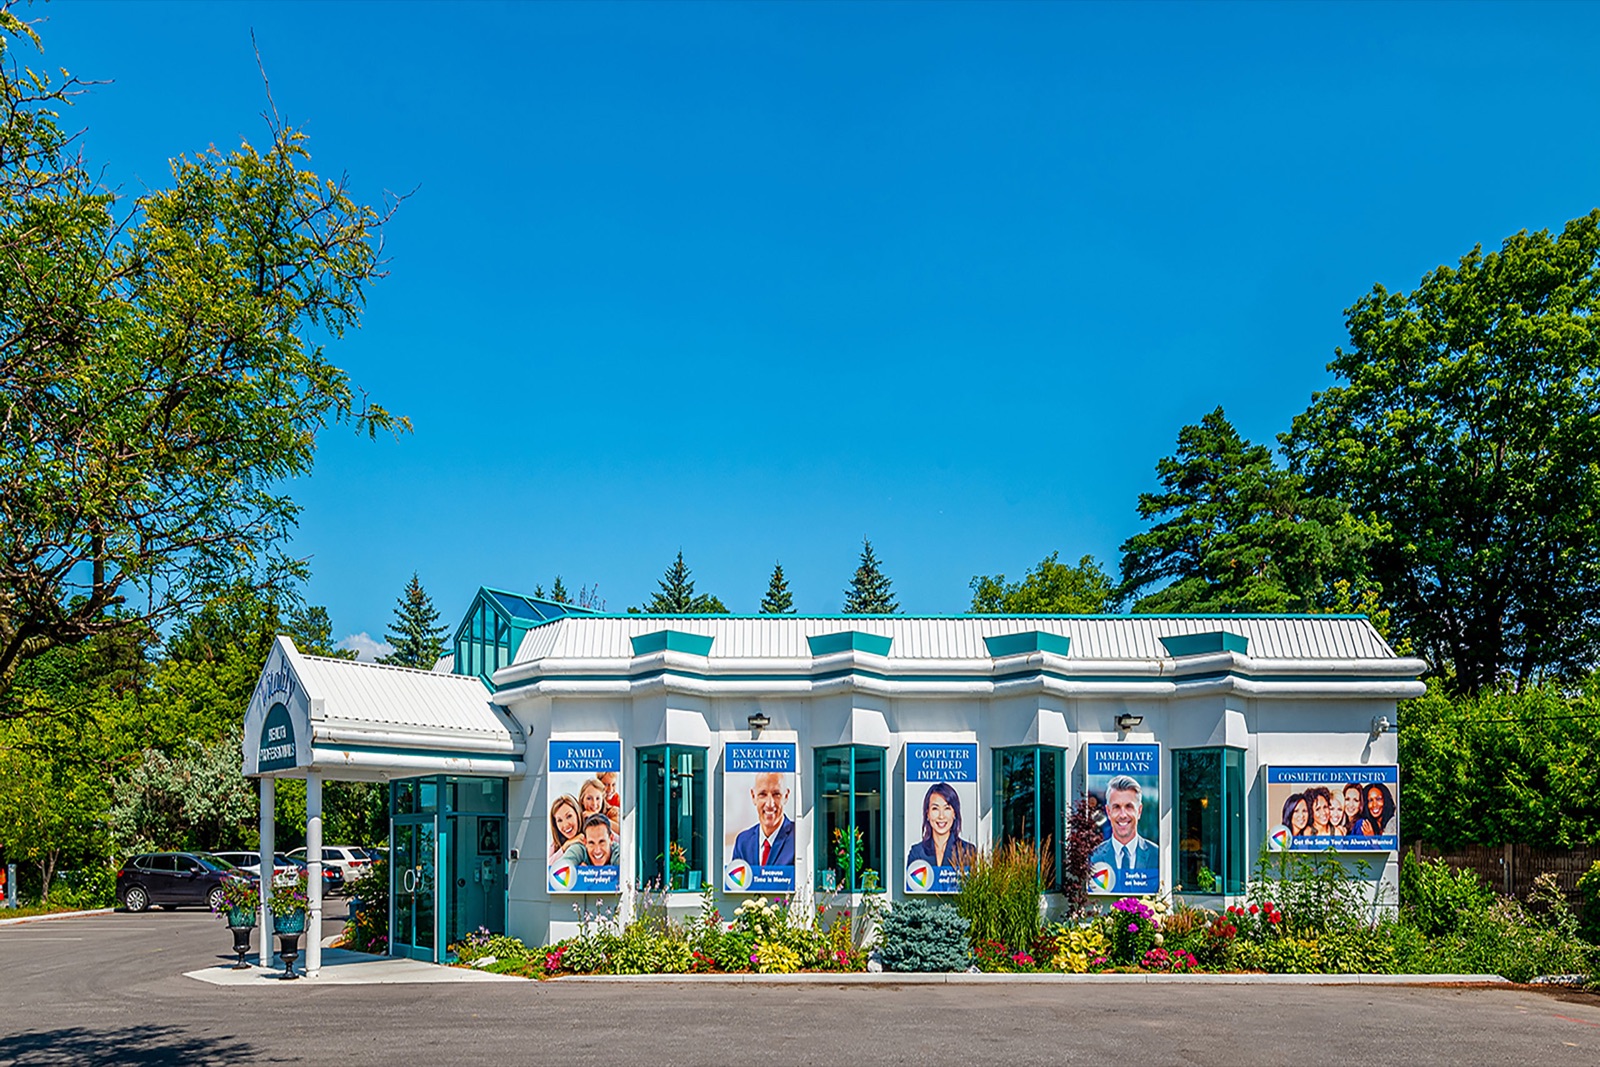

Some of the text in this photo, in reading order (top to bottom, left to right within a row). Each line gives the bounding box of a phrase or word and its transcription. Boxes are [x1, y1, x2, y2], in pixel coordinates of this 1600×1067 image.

[568, 748, 604, 758] FAMILY
[733, 749, 790, 758] EXECUTIVE
[915, 749, 970, 759] COMPUTER
[1095, 751, 1154, 761] IMMEDIATE
[557, 759, 614, 769] DENTISTRY
[733, 759, 789, 769] DENTISTRY
[922, 760, 962, 769] GUIDED
[1099, 762, 1150, 771] IMPLANTS
[917, 770, 968, 780] IMPLANTS
[1278, 772, 1388, 781] COSMETIC DENTISTRY
[1293, 838, 1393, 847] Get the Smile You've Always Wanted
[577, 868, 617, 877] Healthy Smiles
[583, 876, 611, 885] Everyday!
[773, 876, 791, 885] Money
